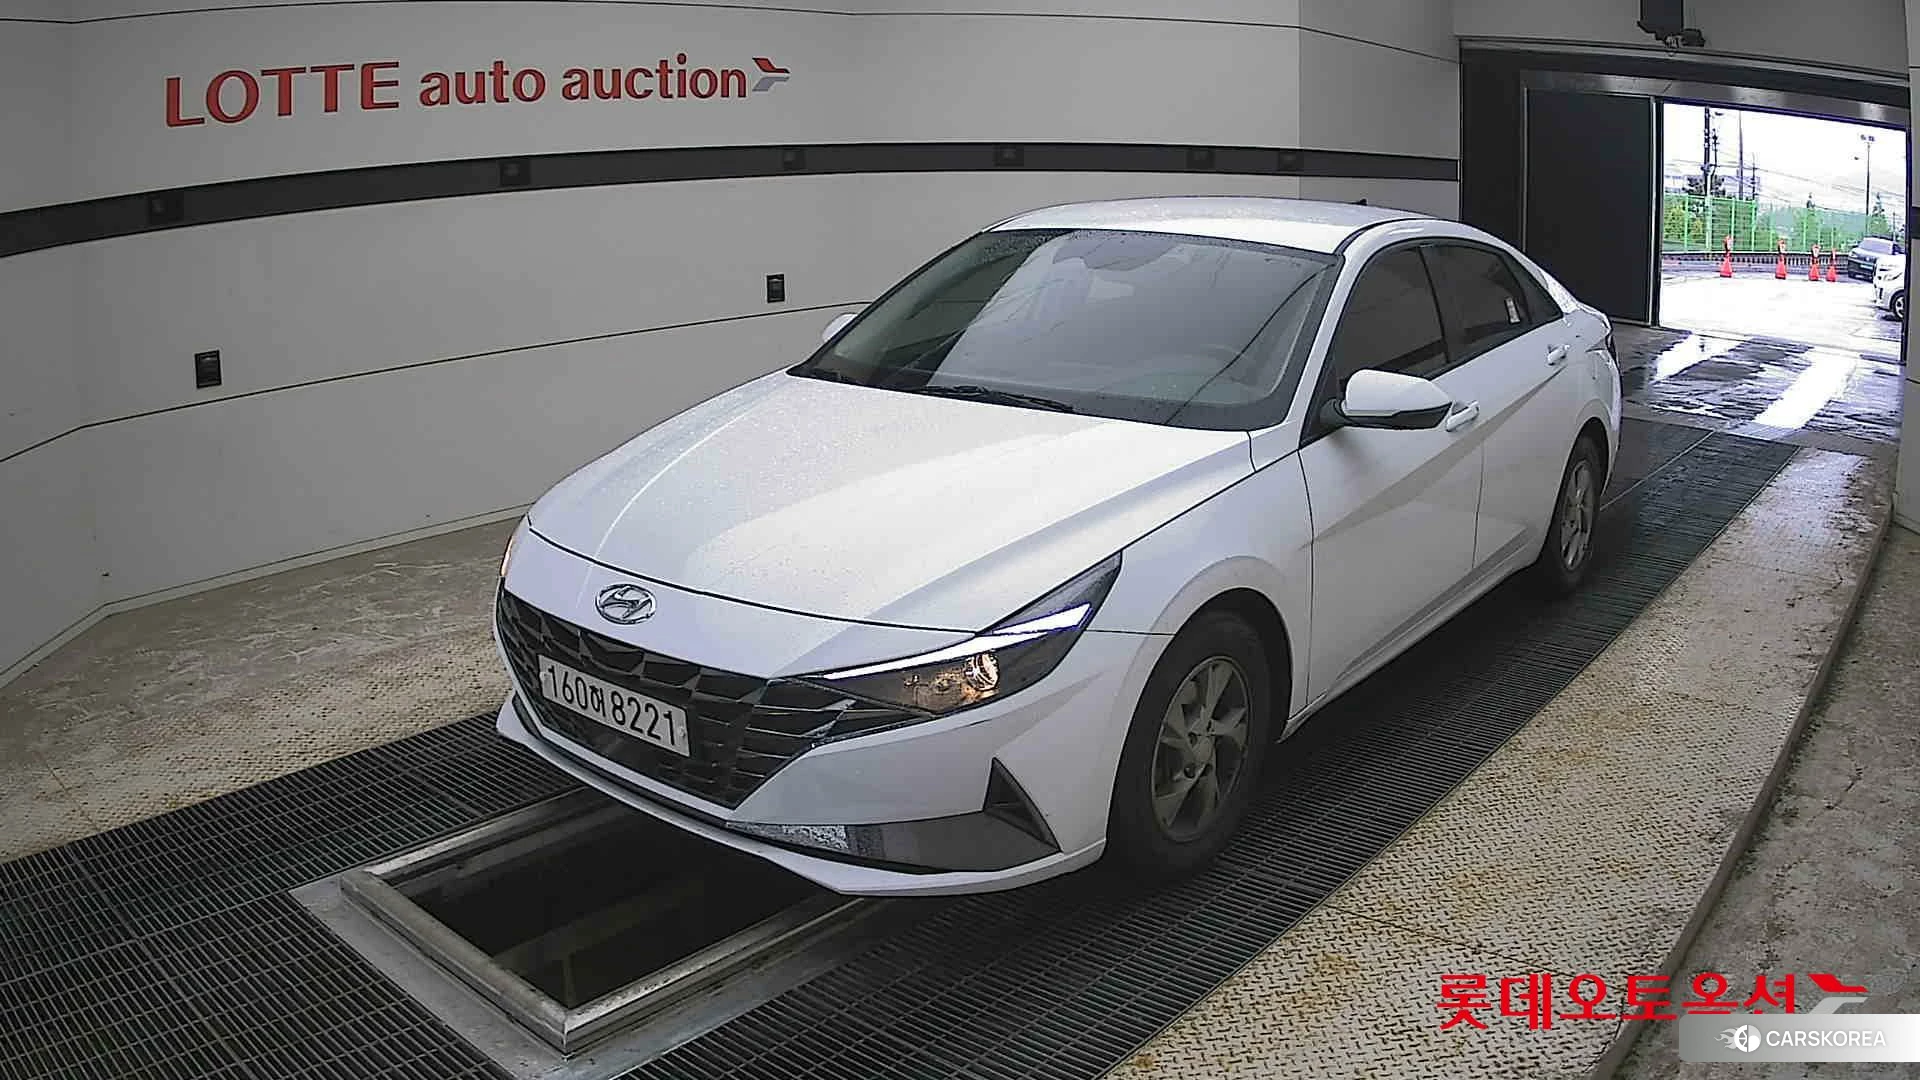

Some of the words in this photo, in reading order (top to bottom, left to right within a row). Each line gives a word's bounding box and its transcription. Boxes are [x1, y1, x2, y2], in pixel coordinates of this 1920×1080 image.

[165, 62, 400, 128] LOTTE
[419, 60, 545, 107] auto
[561, 53, 747, 100] auction
